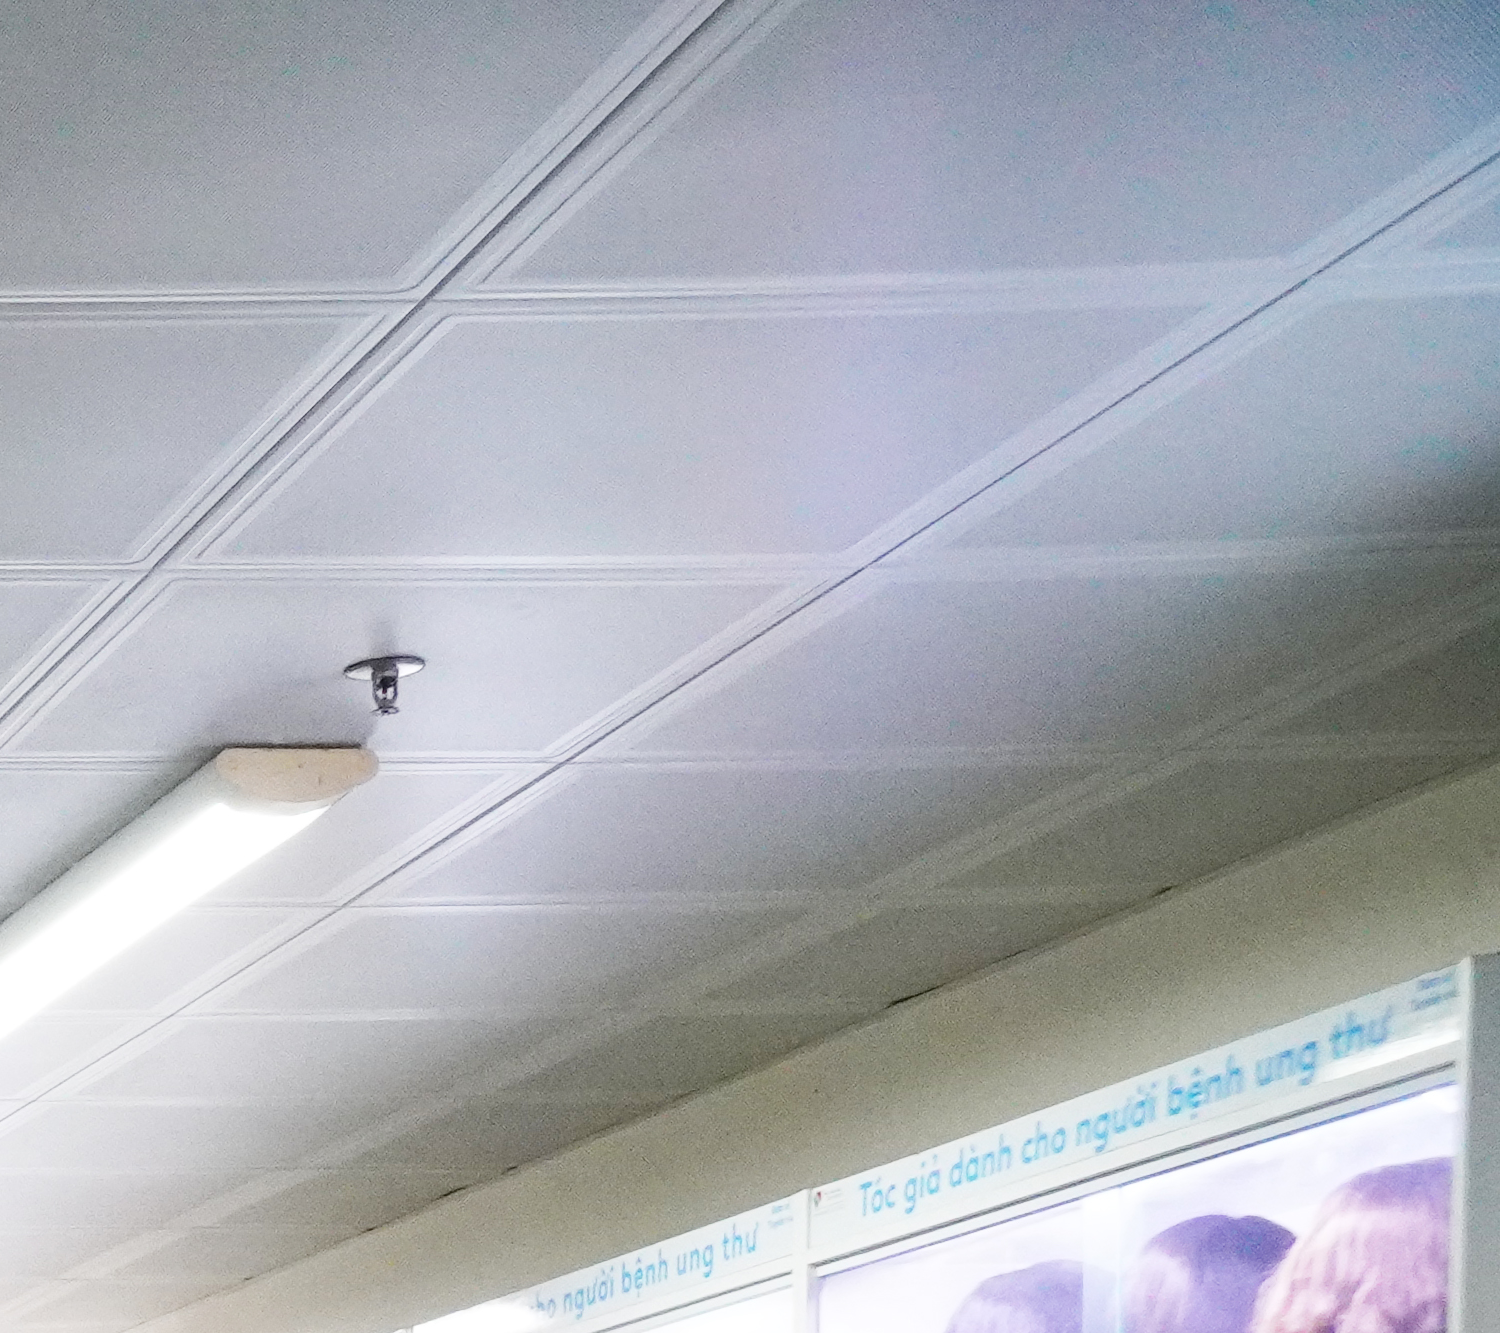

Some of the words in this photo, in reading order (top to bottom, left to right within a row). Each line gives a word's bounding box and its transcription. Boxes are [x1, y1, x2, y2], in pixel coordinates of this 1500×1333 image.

[859, 1176, 896, 1217] Tóc
[904, 1154, 940, 1214] giả
[950, 1132, 1013, 1188] dành
[1021, 1120, 1066, 1164] cho
[1166, 1053, 1245, 1121] bệnh
[1255, 1039, 1318, 1087] ung
[532, 1293, 556, 1319] ho
[621, 1249, 668, 1298] bệnh
[677, 1244, 714, 1278] ung
[722, 1221, 759, 1261] thư
